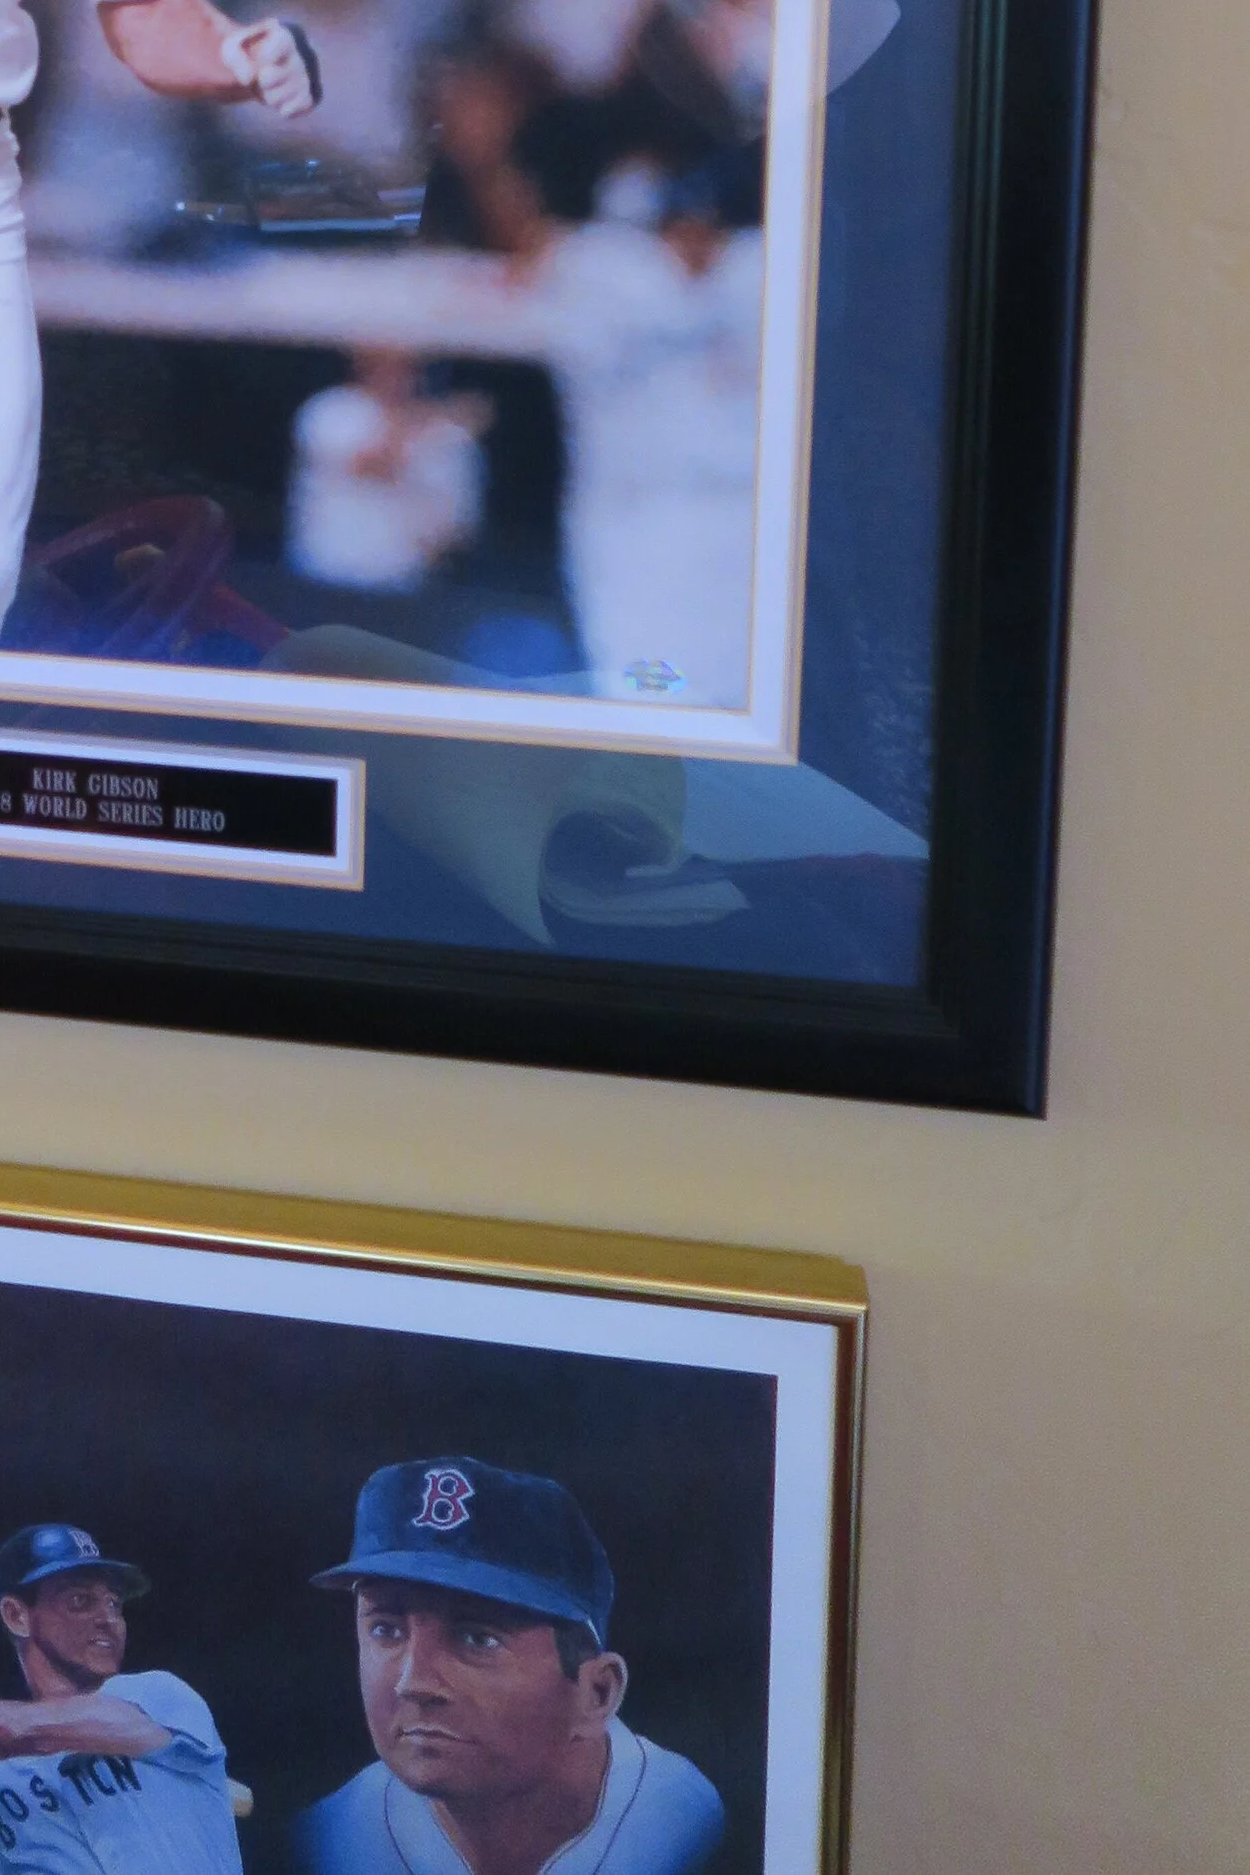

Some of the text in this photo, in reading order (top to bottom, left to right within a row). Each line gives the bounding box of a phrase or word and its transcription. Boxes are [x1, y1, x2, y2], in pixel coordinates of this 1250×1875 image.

[32, 767, 159, 800] KIRK GIBSON
[22, 793, 88, 820] WORLD
[98, 801, 164, 826] SERIES
[173, 806, 226, 832] HERO
[413, 1468, 475, 1530] B
